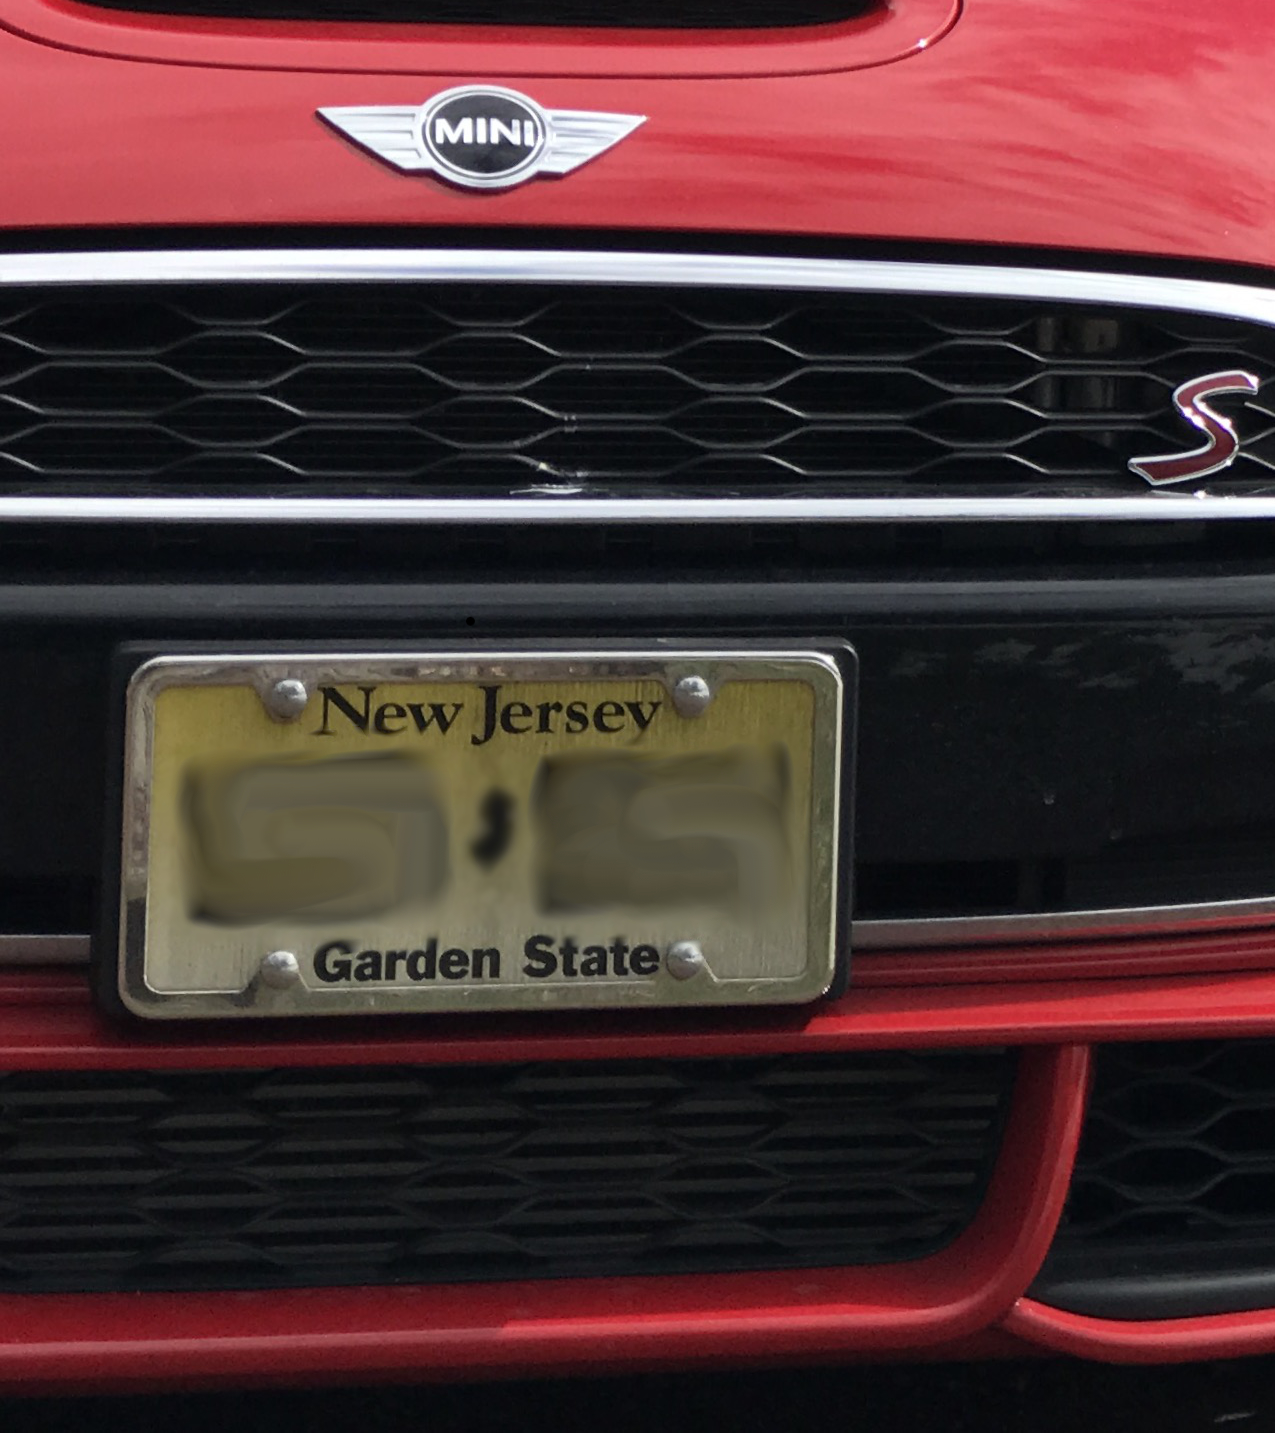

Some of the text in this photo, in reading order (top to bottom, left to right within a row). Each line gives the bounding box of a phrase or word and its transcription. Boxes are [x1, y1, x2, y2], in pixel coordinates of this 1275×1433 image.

[435, 117, 535, 147] MINI
[1127, 370, 1260, 486] S
[310, 685, 663, 746] New Jersey
[313, 934, 660, 983] Garden State
